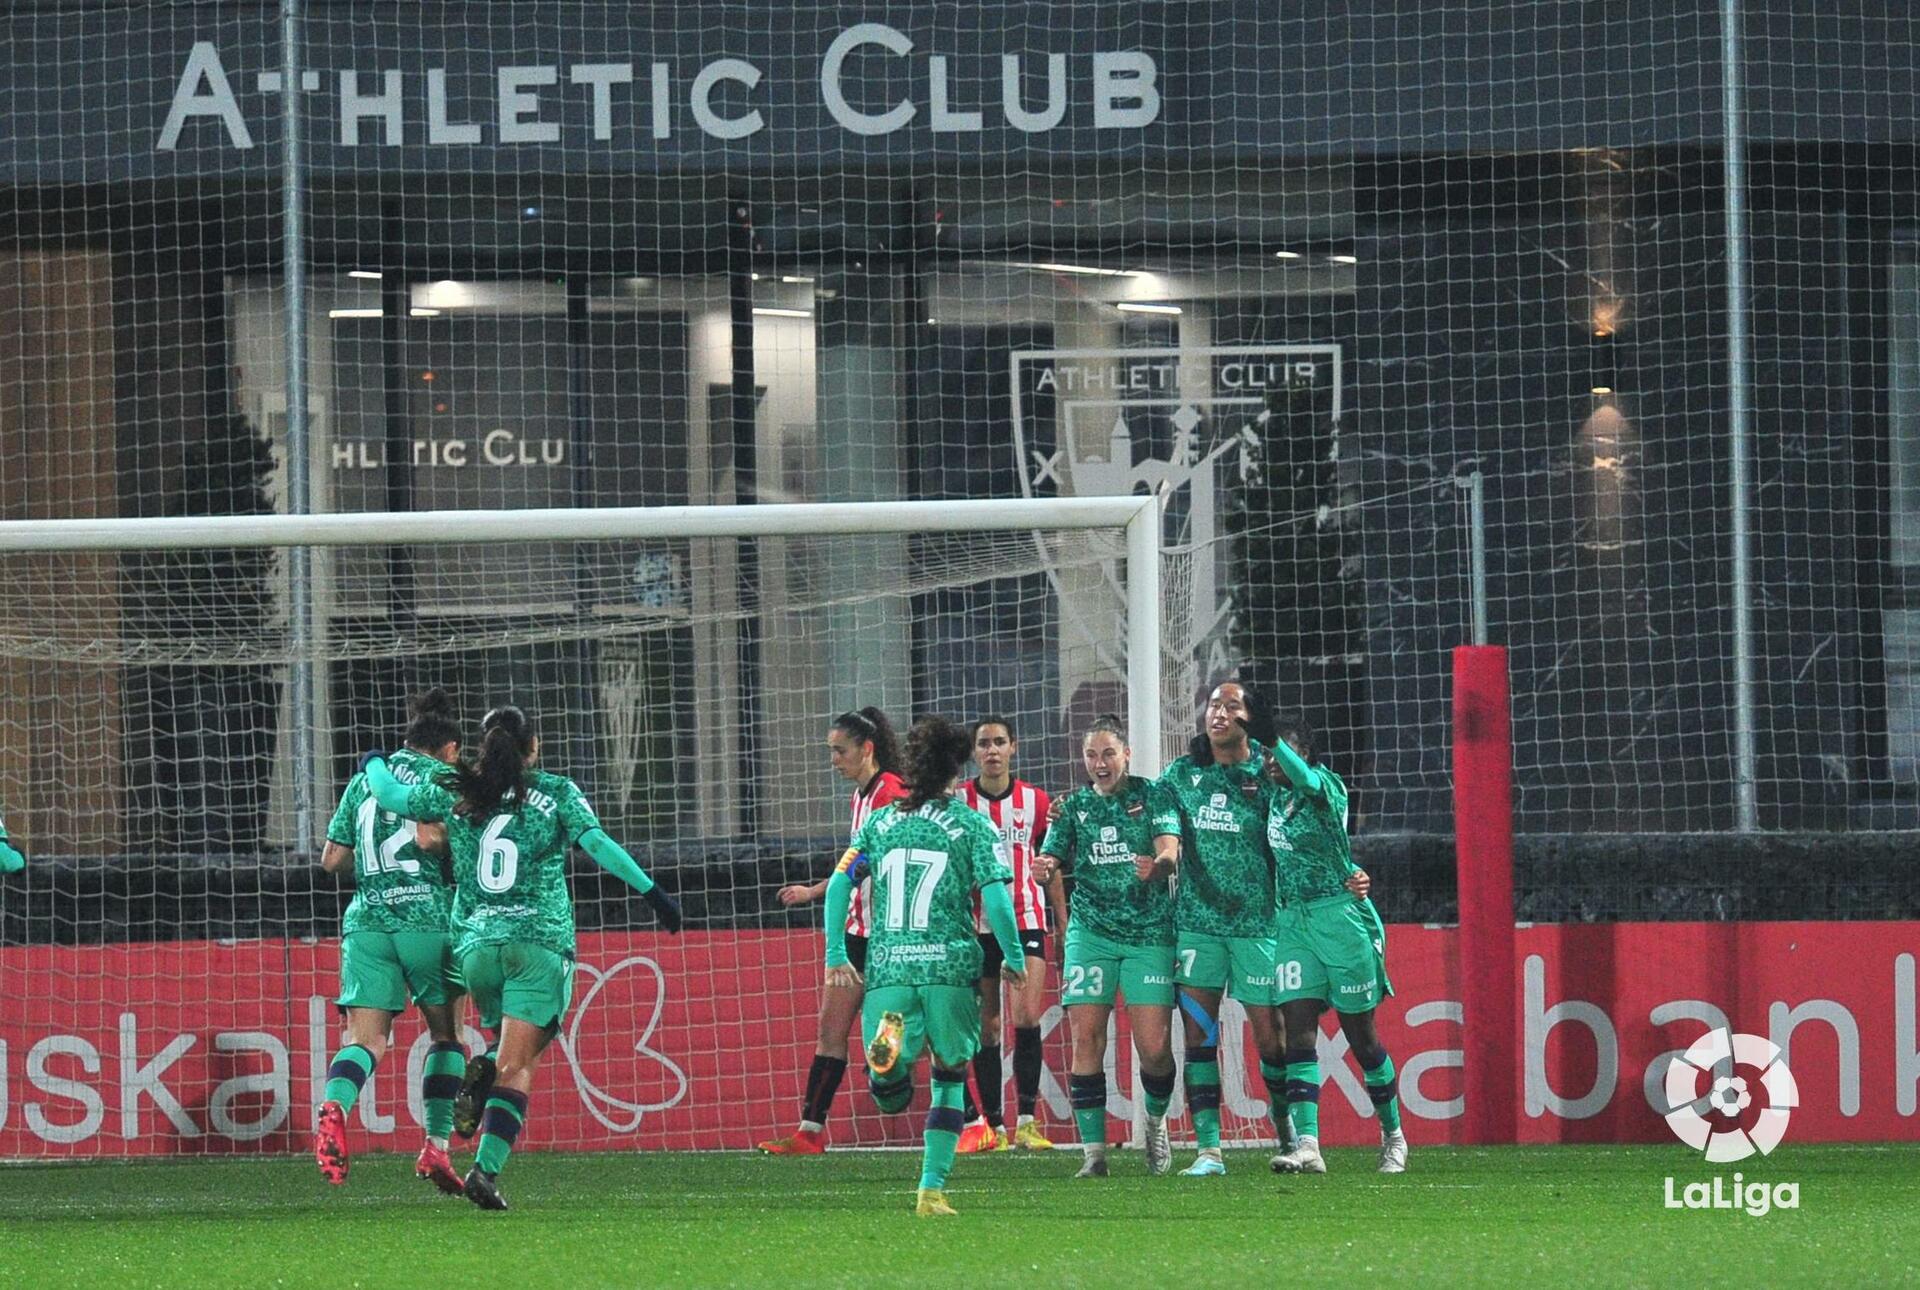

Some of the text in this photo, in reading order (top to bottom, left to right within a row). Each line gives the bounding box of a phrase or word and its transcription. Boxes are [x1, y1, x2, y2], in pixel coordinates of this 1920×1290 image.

[820, 22, 1160, 136] CLUB
[1036, 363, 1207, 391] ATHLETIC
[482, 429, 592, 467] CLU
[1192, 817, 1240, 832] Valencia
[1199, 805, 1233, 821] Fibra
[358, 796, 421, 876] 12
[1092, 841, 1128, 855] Fibra
[477, 814, 518, 894] 6
[382, 884, 432, 899] GERMAINE
[879, 847, 949, 932] 17
[891, 944, 947, 954] GERMAINE
[1181, 949, 1197, 978] 7
[1068, 965, 1103, 997] 23
[1275, 960, 1302, 992] 18
